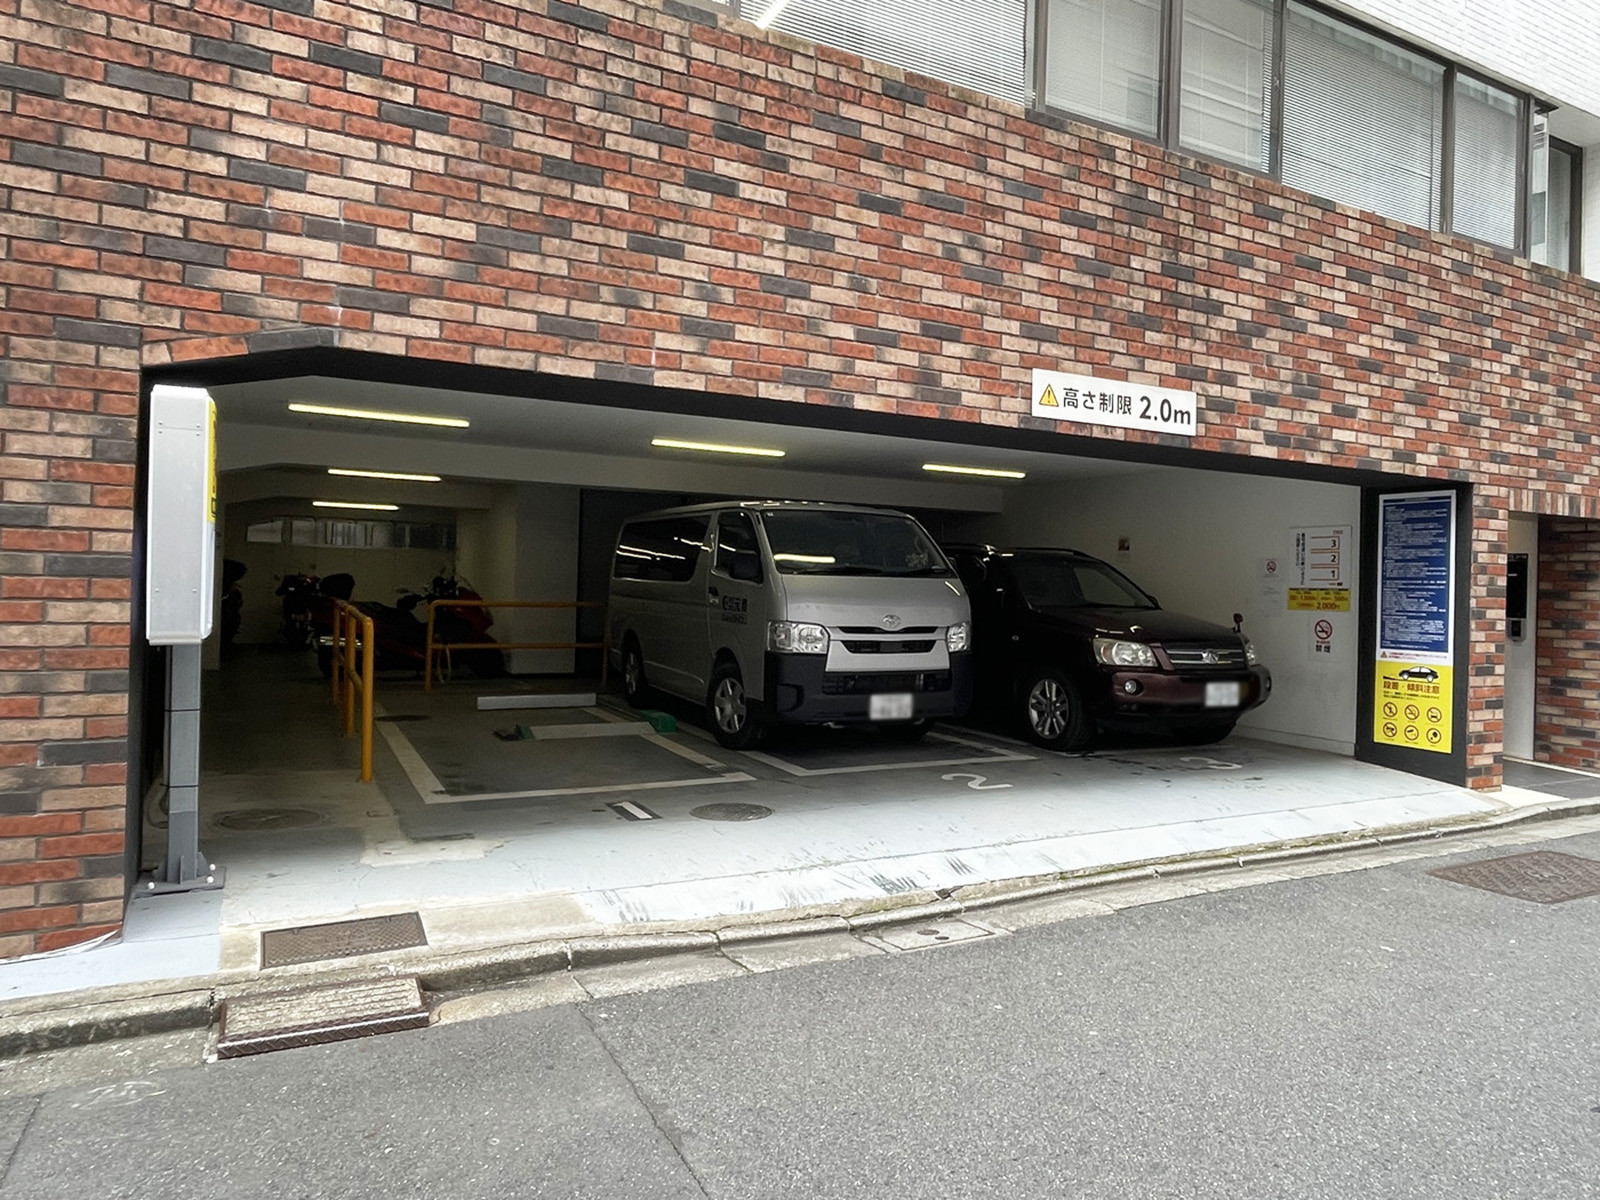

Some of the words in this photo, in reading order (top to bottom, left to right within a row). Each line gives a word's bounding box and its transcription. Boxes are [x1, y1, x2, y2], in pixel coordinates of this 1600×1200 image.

[1063, 387, 1132, 415] 高さ制限
[1139, 395, 1191, 425] 2.0m
[1330, 539, 1337, 548] 3
[1330, 554, 1337, 563] 2
[1330, 569, 1336, 578] 1
[1179, 756, 1243, 770] 3
[941, 773, 1013, 790] 2
